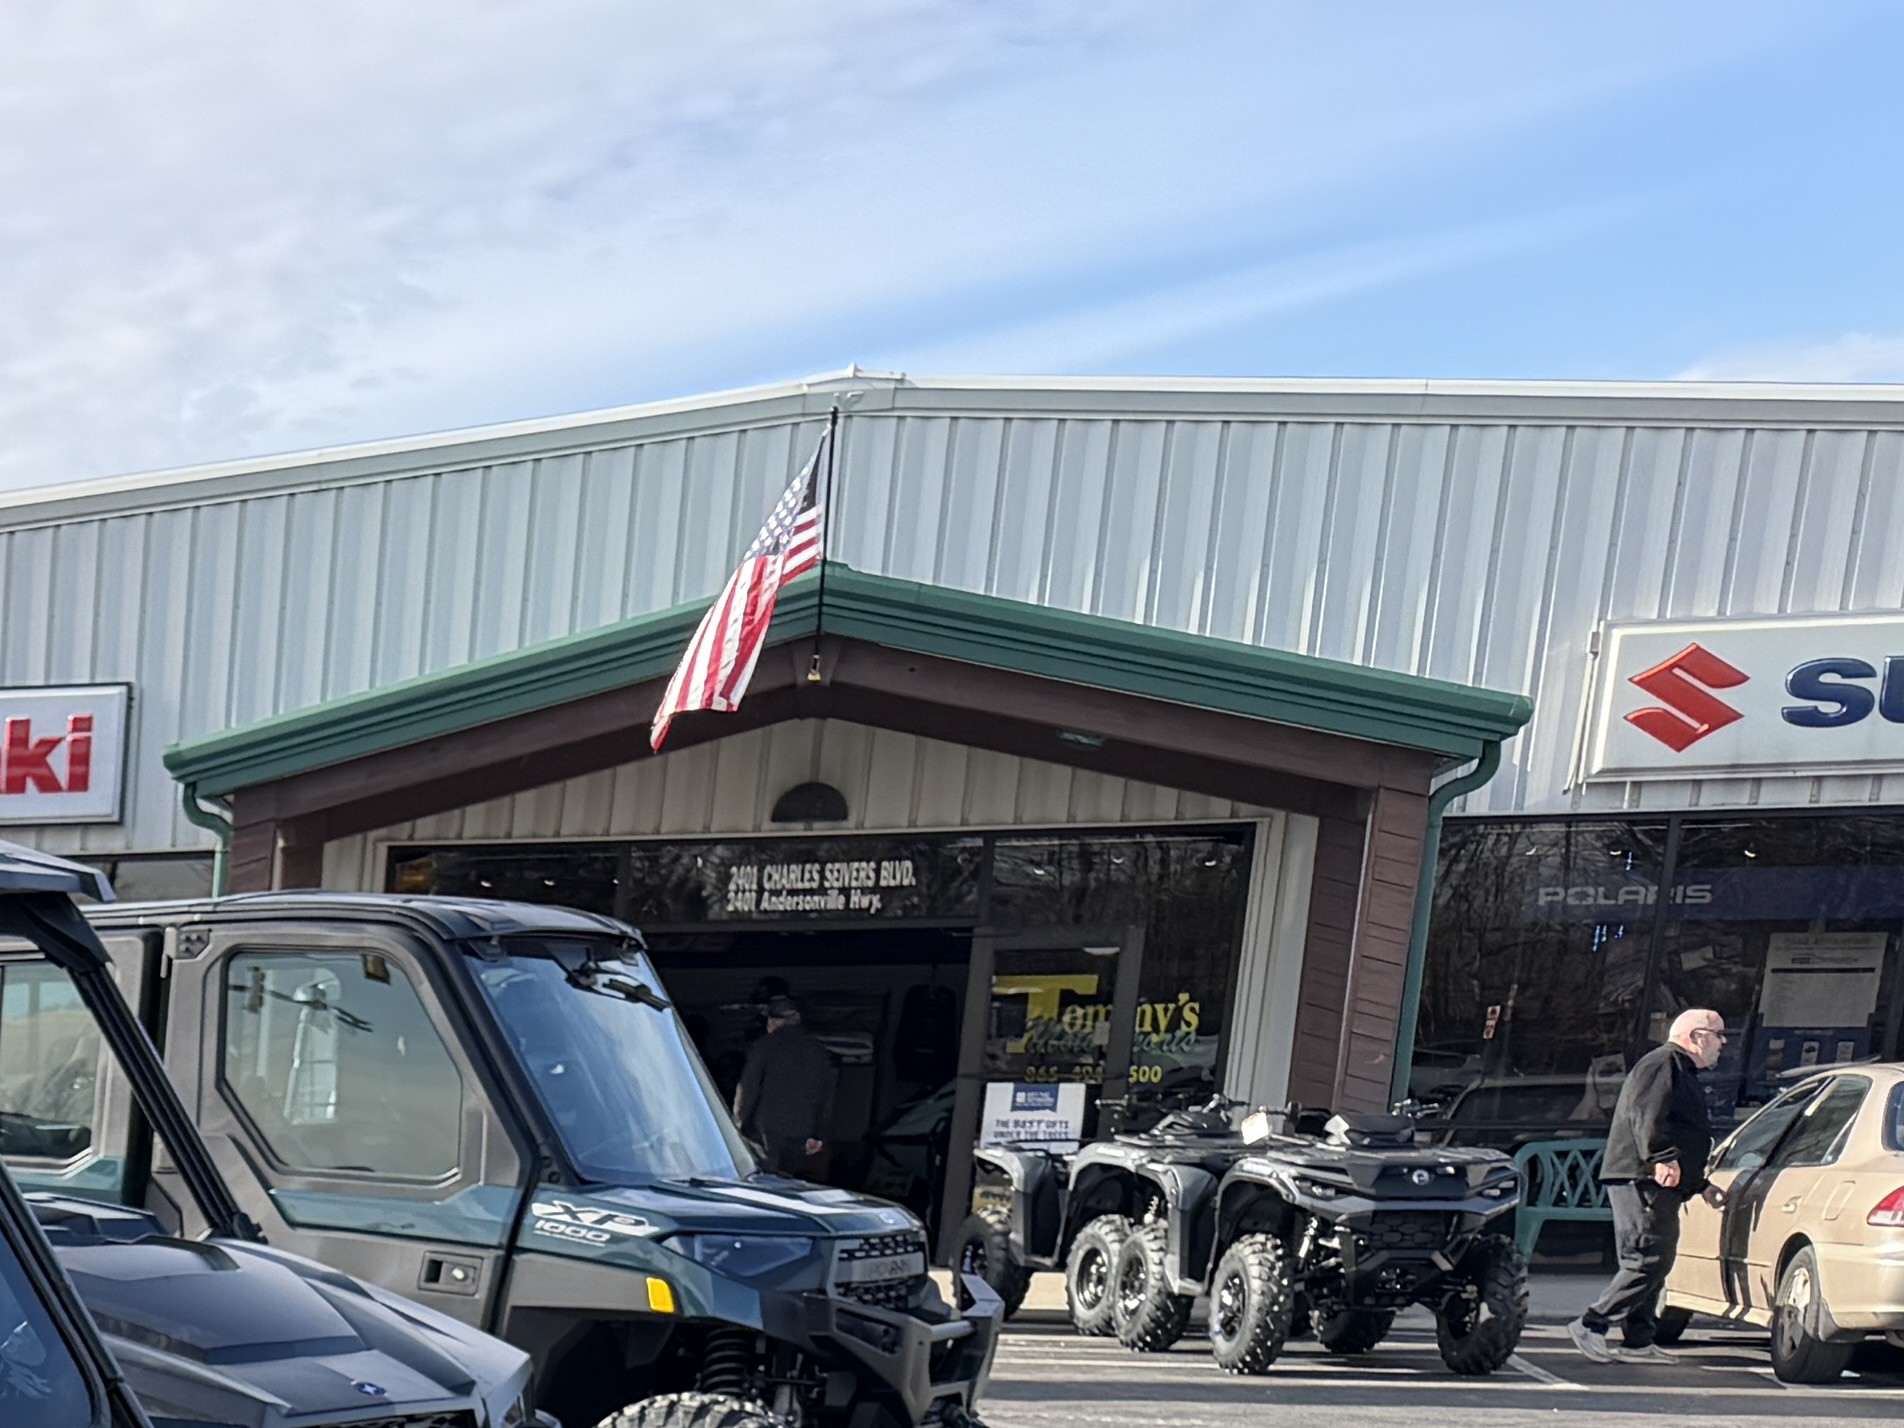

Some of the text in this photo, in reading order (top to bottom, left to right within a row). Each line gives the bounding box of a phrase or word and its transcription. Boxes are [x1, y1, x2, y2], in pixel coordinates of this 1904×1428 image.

[728, 865, 758, 891] 2401
[763, 863, 820, 889] CHARLES
[879, 860, 917, 887] BLVD.
[759, 889, 846, 911] Andersonville
[535, 1219, 611, 1242] 1000
